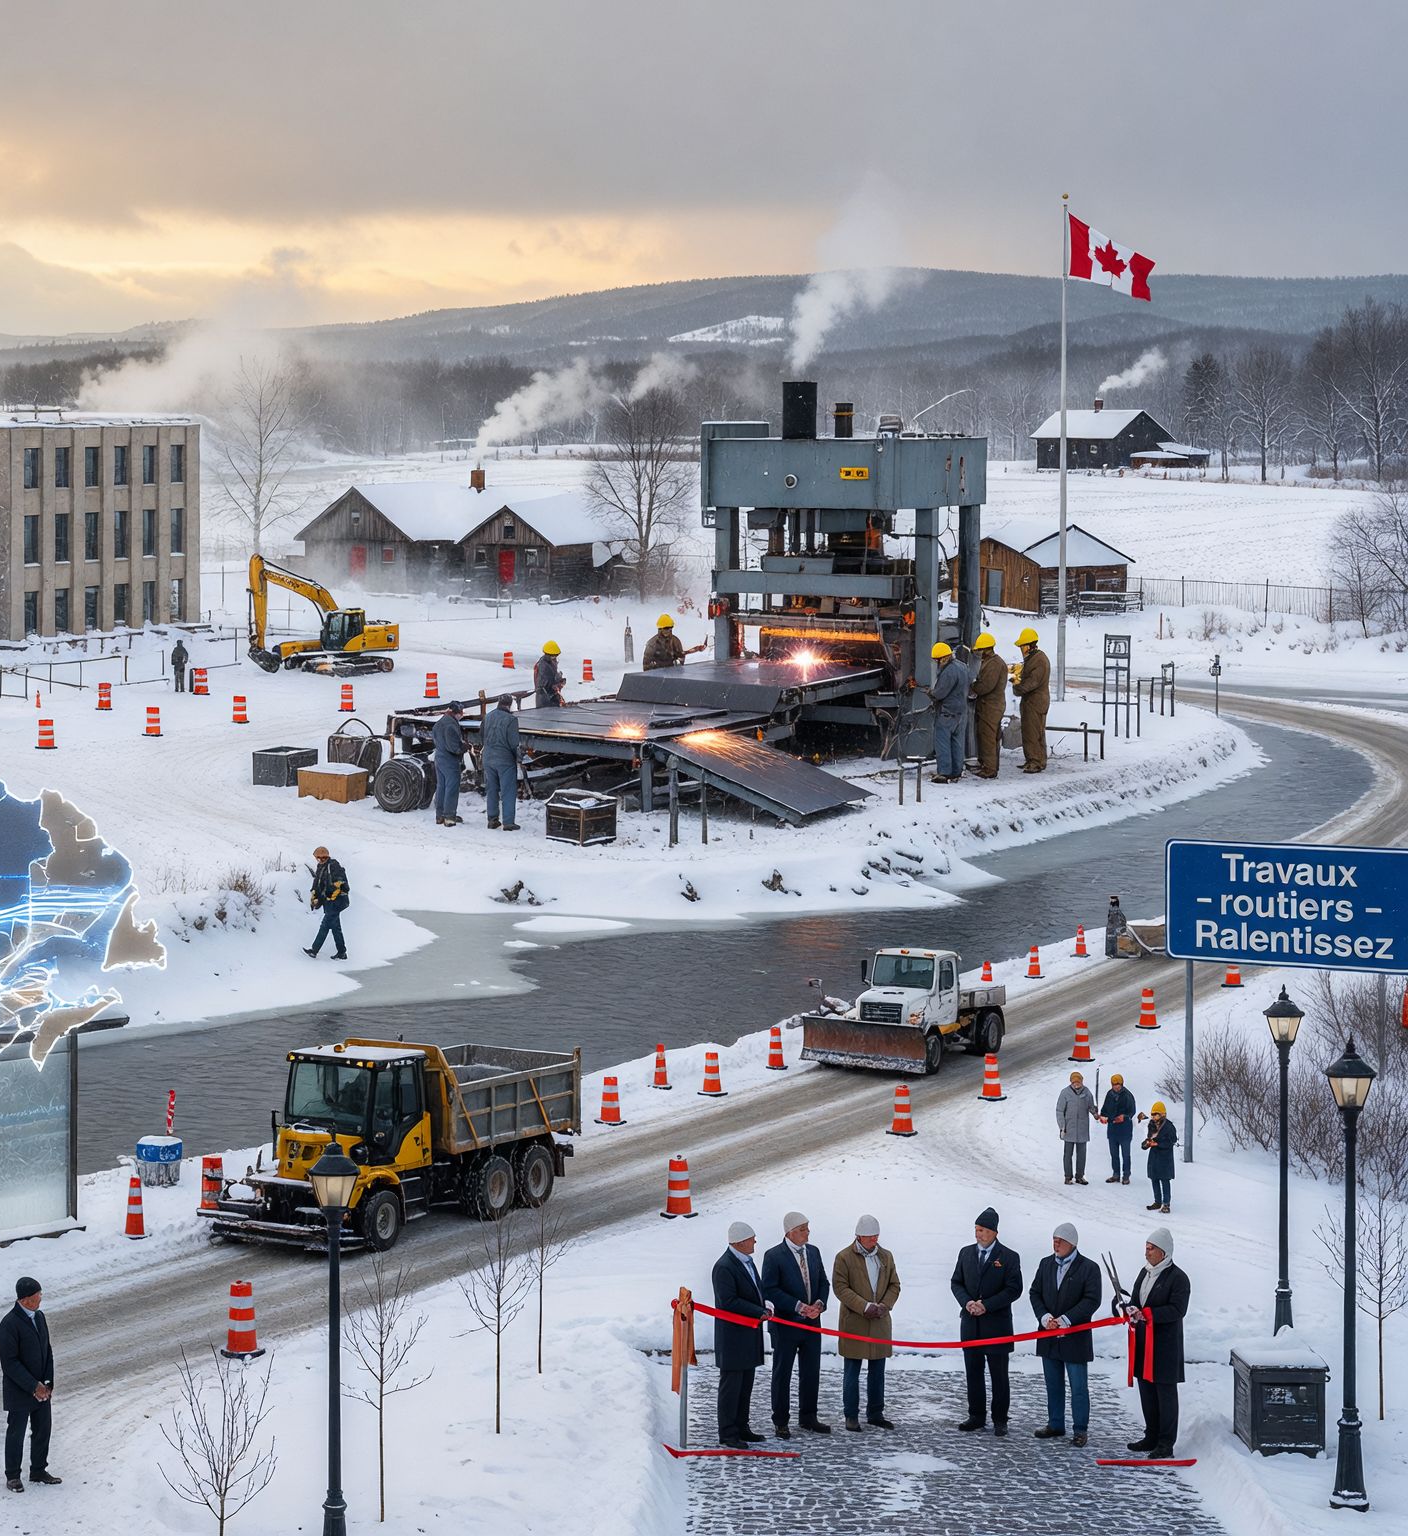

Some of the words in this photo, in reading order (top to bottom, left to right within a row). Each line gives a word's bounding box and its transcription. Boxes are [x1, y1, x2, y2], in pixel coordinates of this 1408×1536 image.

[1221, 853, 1358, 888] Travaux
[1220, 890, 1354, 923] routiers
[1195, 919, 1394, 960] Ralentissez
